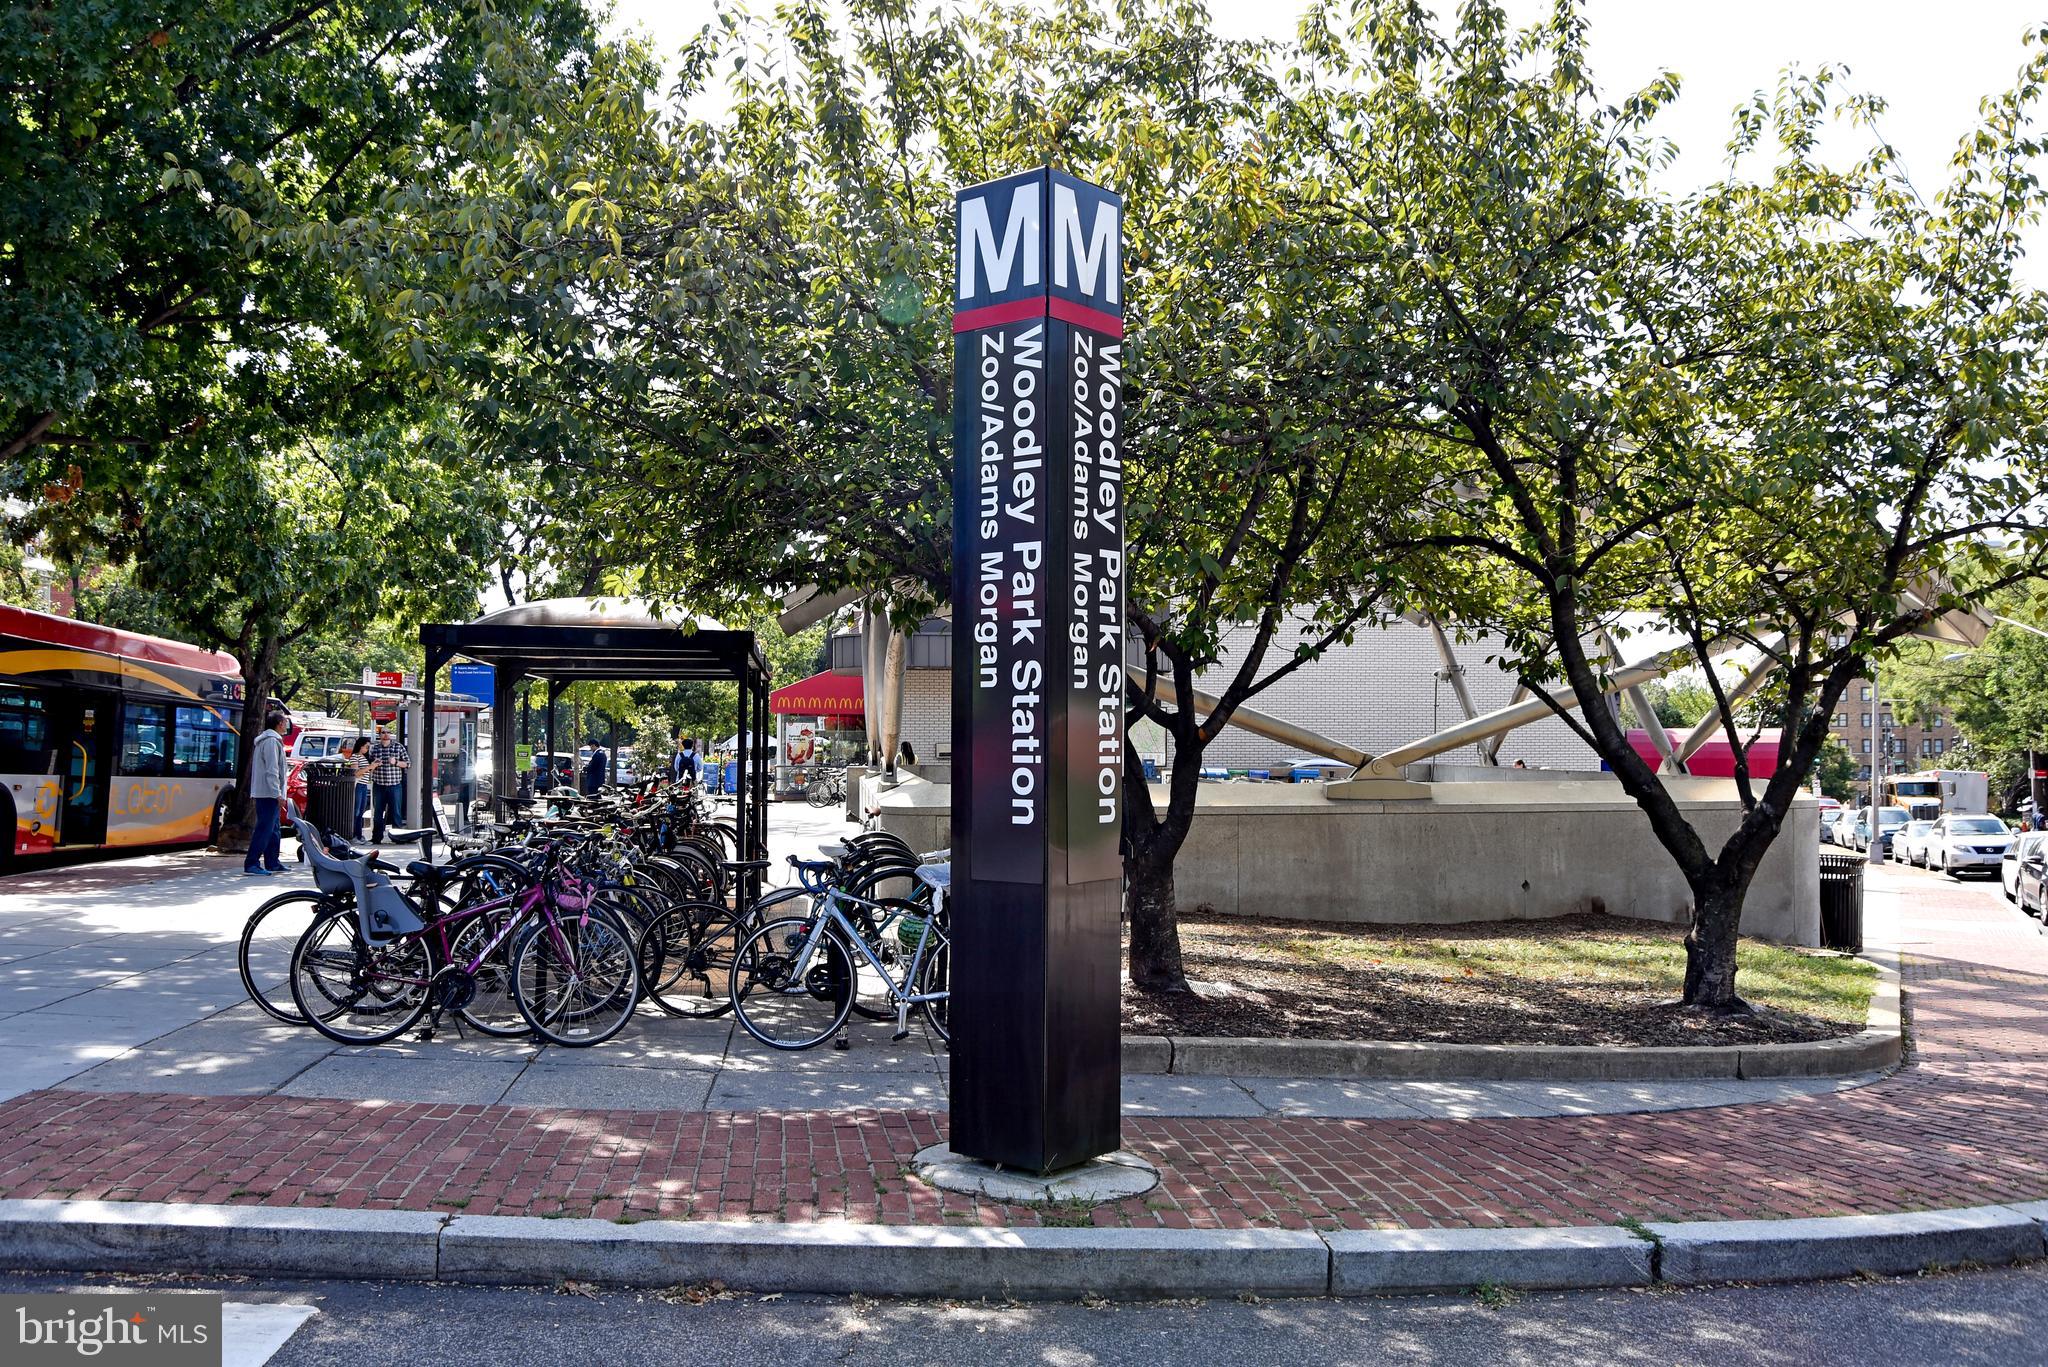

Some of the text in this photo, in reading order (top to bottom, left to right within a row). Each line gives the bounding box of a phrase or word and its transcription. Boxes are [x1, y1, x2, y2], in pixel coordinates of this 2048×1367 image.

[959, 181, 1040, 300] M
[1054, 182, 1118, 305] M
[973, 331, 1005, 688] Zoo/Adams Morgan
[1006, 323, 1043, 825] Woodley Park Station
[1068, 330, 1094, 689] Zoo/Adams Morgan
[1094, 344, 1122, 824] Woodley Park Station
[479, 909, 522, 963] FUJI
